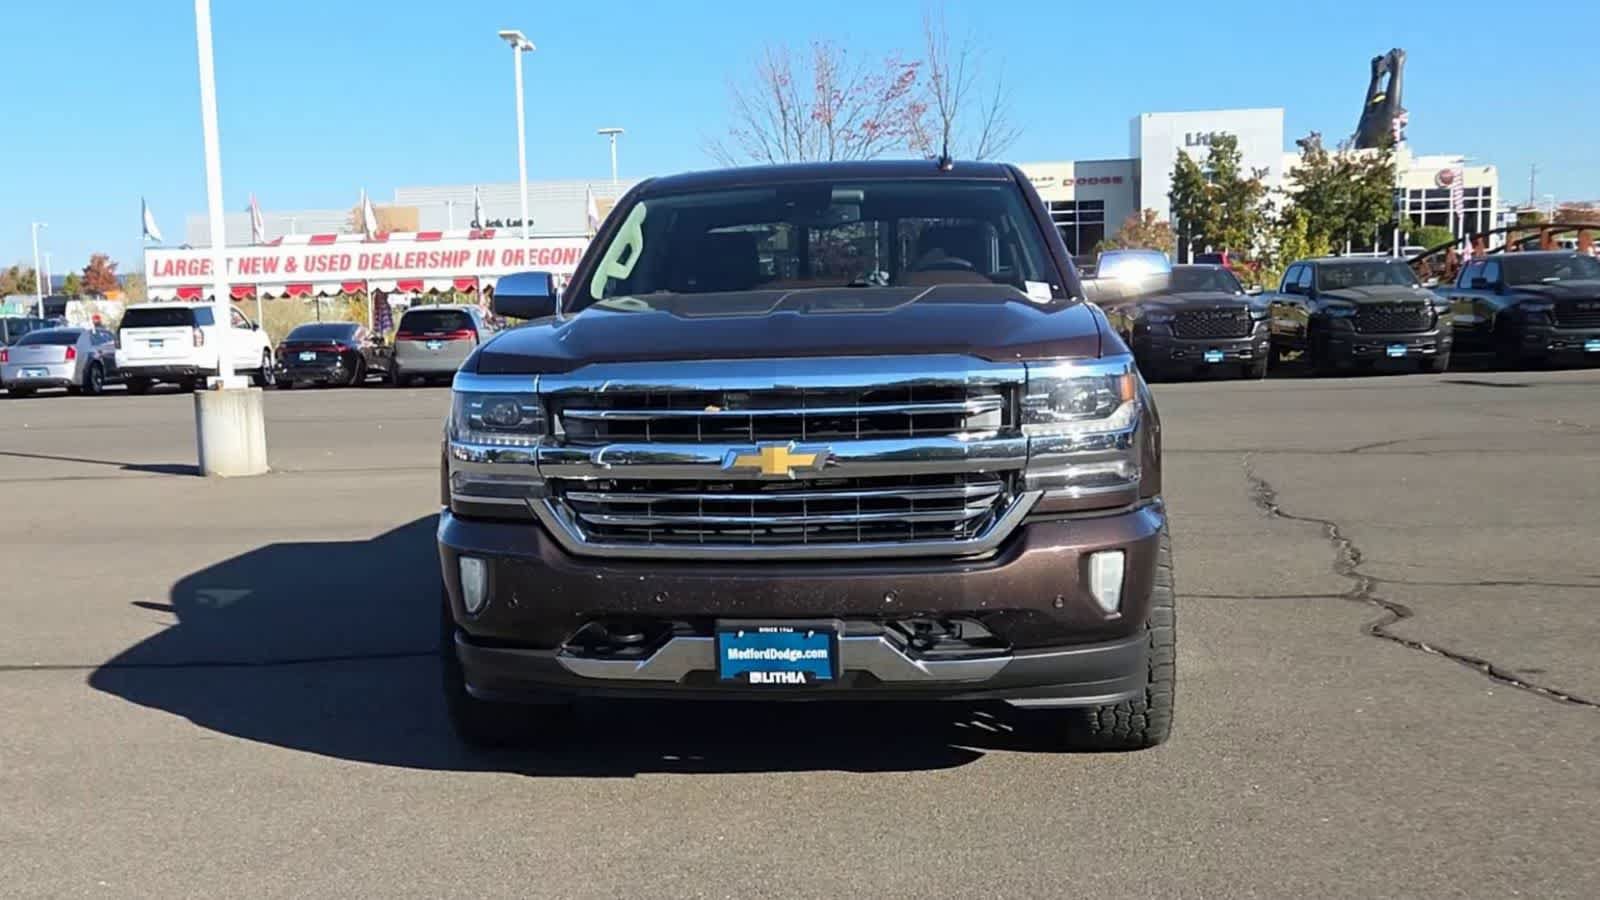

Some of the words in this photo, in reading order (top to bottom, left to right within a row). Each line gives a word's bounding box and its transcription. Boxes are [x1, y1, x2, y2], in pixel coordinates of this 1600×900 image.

[1063, 176, 1123, 187] DODGE
[470, 218, 504, 229] Qick
[152, 257, 234, 277] LARGET
[238, 256, 280, 276] NEW
[284, 255, 297, 273] &
[304, 253, 352, 273] USED
[358, 249, 472, 271] DEALERSHIP
[475, 248, 497, 268] IN
[727, 648, 828, 662] MedfordDodge.com
[762, 671, 807, 684] LITHIA
